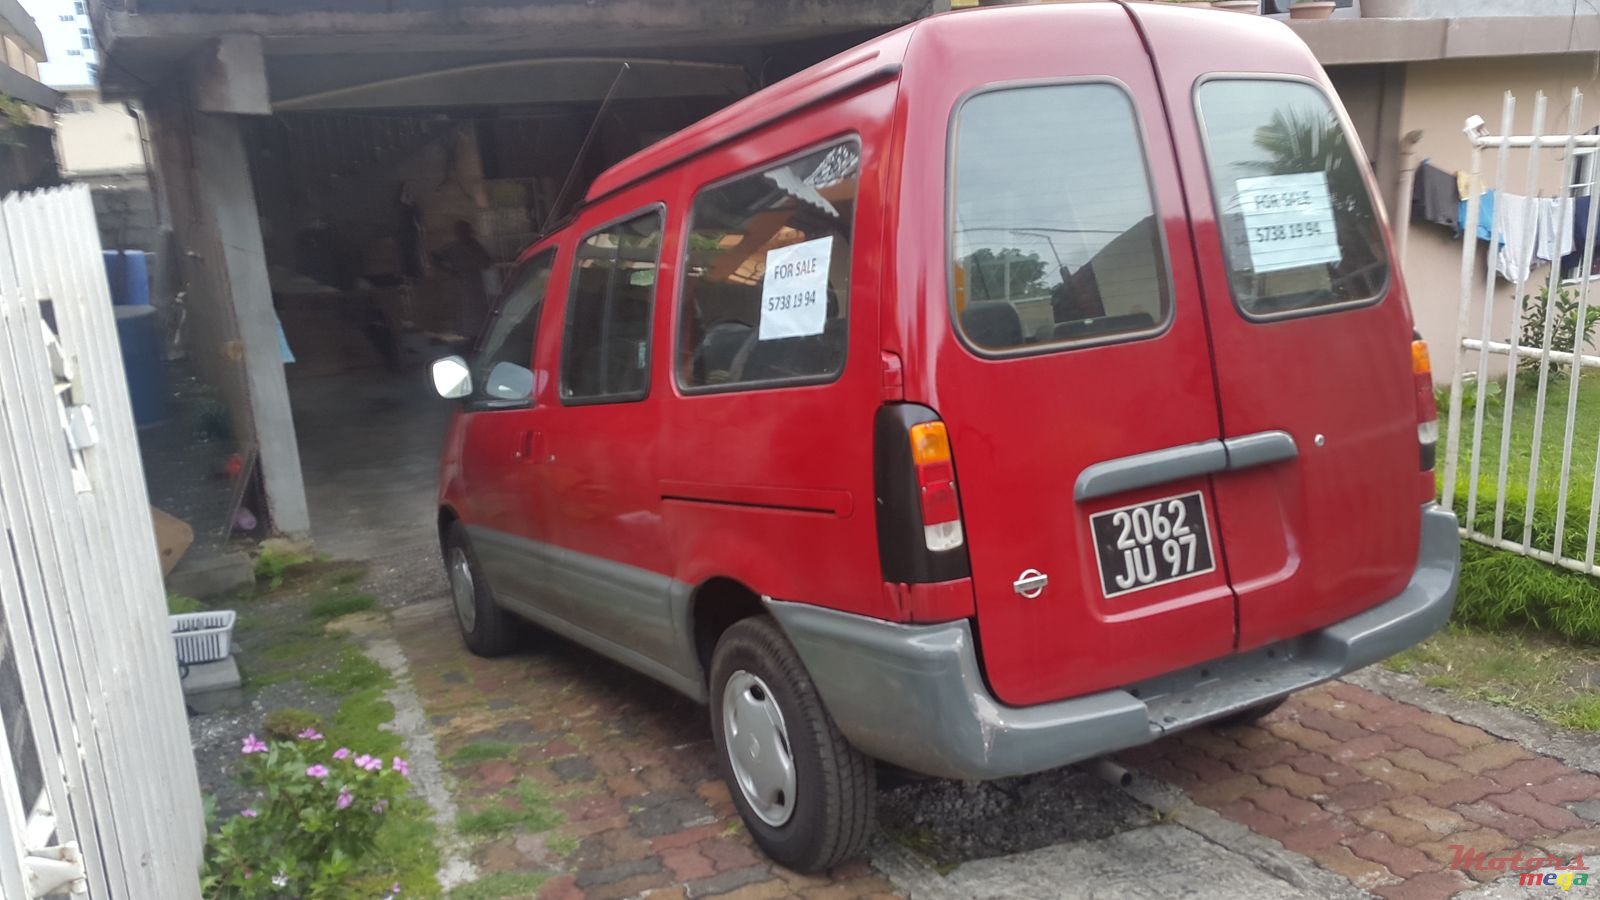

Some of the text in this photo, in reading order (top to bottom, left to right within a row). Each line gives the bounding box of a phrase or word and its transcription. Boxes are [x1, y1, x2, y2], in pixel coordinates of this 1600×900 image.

[1254, 190, 1312, 209] FOR SALE
[1256, 221, 1321, 243] 5738 19 94
[774, 257, 817, 280] FOR SALE
[768, 290, 816, 311] 5738 19 94
[1113, 500, 1190, 550] 2062
[1116, 533, 1197, 589] JU 97
